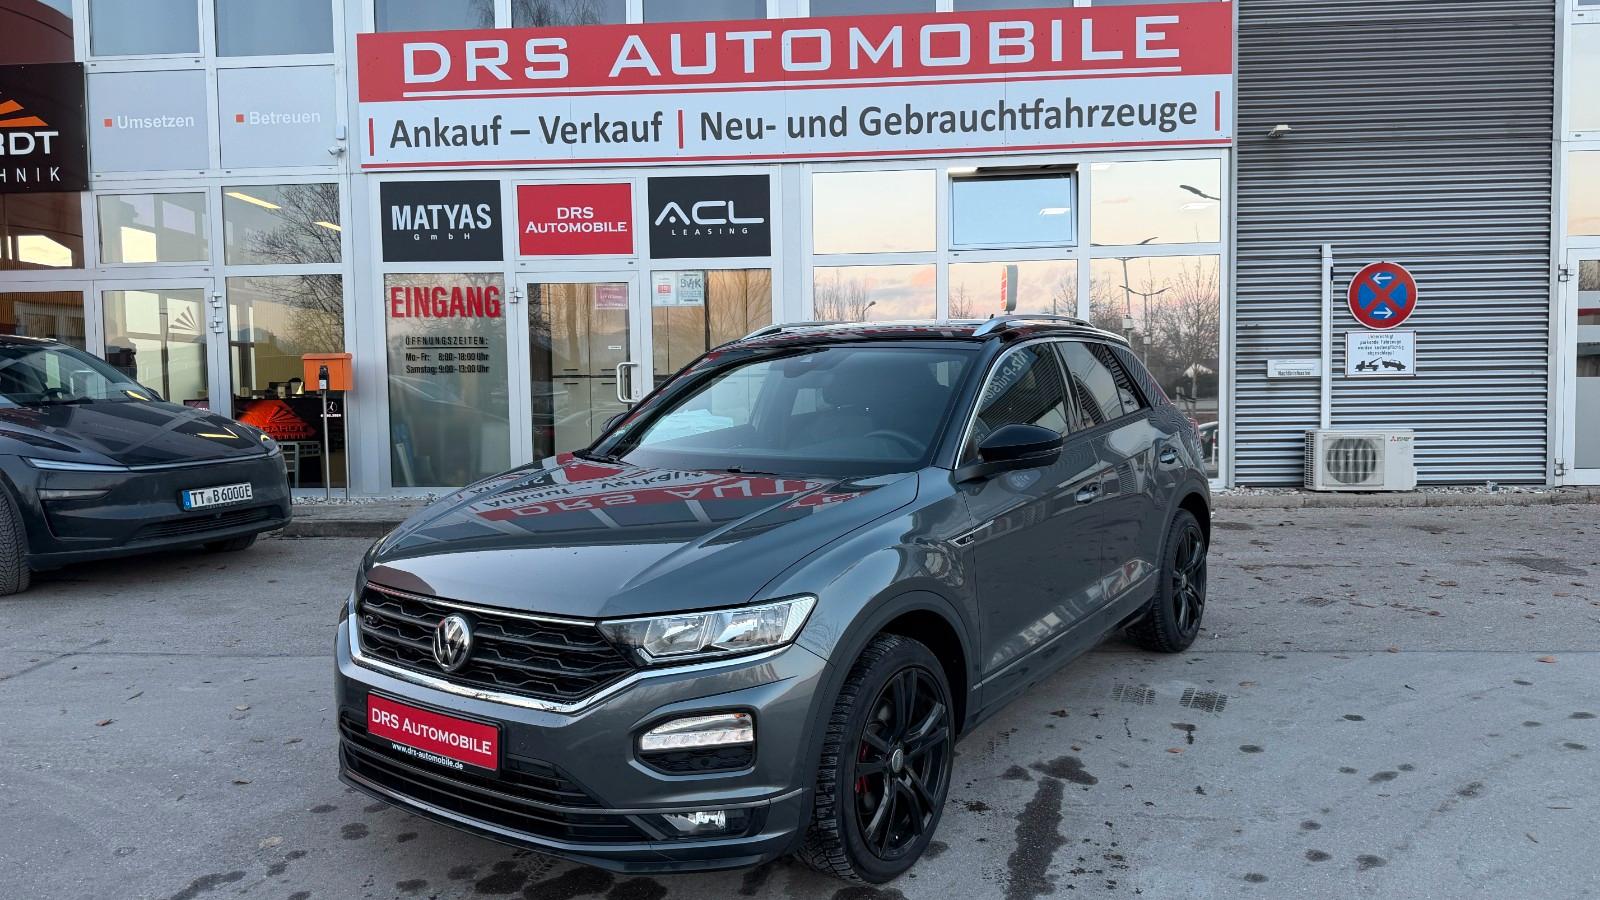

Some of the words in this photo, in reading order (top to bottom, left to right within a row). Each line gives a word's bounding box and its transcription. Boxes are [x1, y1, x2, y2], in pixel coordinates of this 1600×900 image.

[402, 37, 569, 84] DRS
[608, 15, 1180, 78] AUTOMOBILE
[117, 113, 194, 131] Umsetzen
[249, 109, 321, 126] Betreuen
[389, 114, 502, 148] Ankauf
[538, 111, 663, 145] Verkauf
[700, 111, 776, 141] Neu-
[786, 105, 848, 138] und
[858, 97, 1198, 137] Gebrauchtfahrzeuge
[0, 131, 59, 156] DT
[391, 203, 492, 232] MATYAS
[557, 206, 594, 220] DRS
[655, 200, 765, 226] ACL
[413, 232, 471, 241] GmbH
[671, 227, 749, 236] LEASING
[391, 285, 501, 319] EINGANG
[477, 352, 489, 361] Uhr
[477, 364, 489, 374] Uhr
[191, 491, 205, 506] TT
[371, 708, 400, 728] DRS
[391, 742, 464, 770] www.drs-automobile.de
